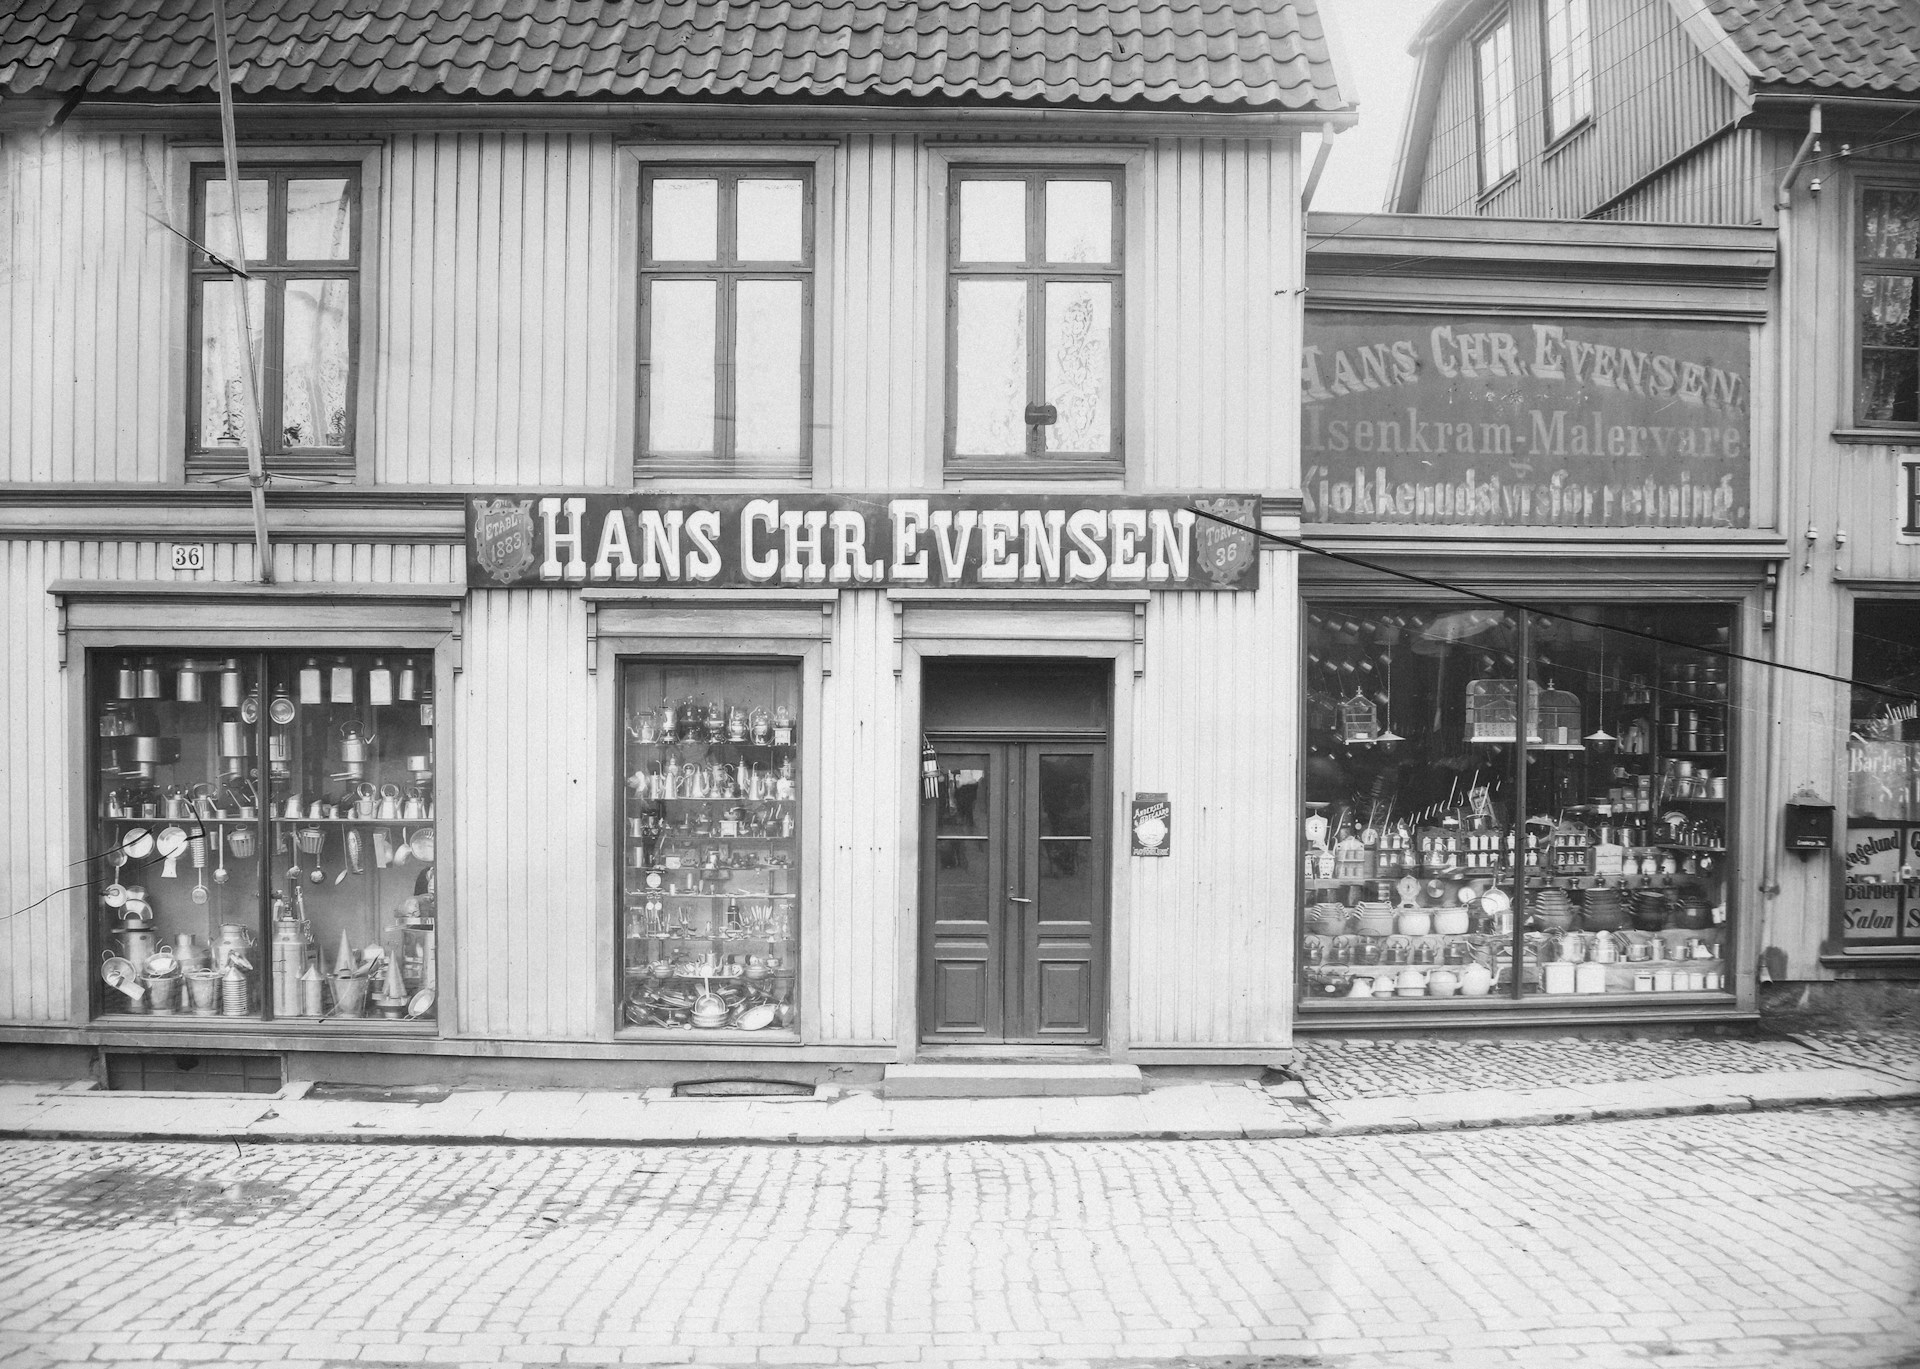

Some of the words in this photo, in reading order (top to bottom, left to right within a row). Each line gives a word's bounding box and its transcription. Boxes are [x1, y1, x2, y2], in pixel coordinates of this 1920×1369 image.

[1430, 324, 1529, 378] CHR.
[176, 547, 199, 566] 36
[539, 498, 722, 582] HANS
[740, 499, 885, 583] CHR.
[887, 499, 1195, 583] EVENSEN
[1216, 542, 1237, 566] 36
[1845, 830, 1900, 870] agelund
[1843, 907, 1894, 930] Salon
